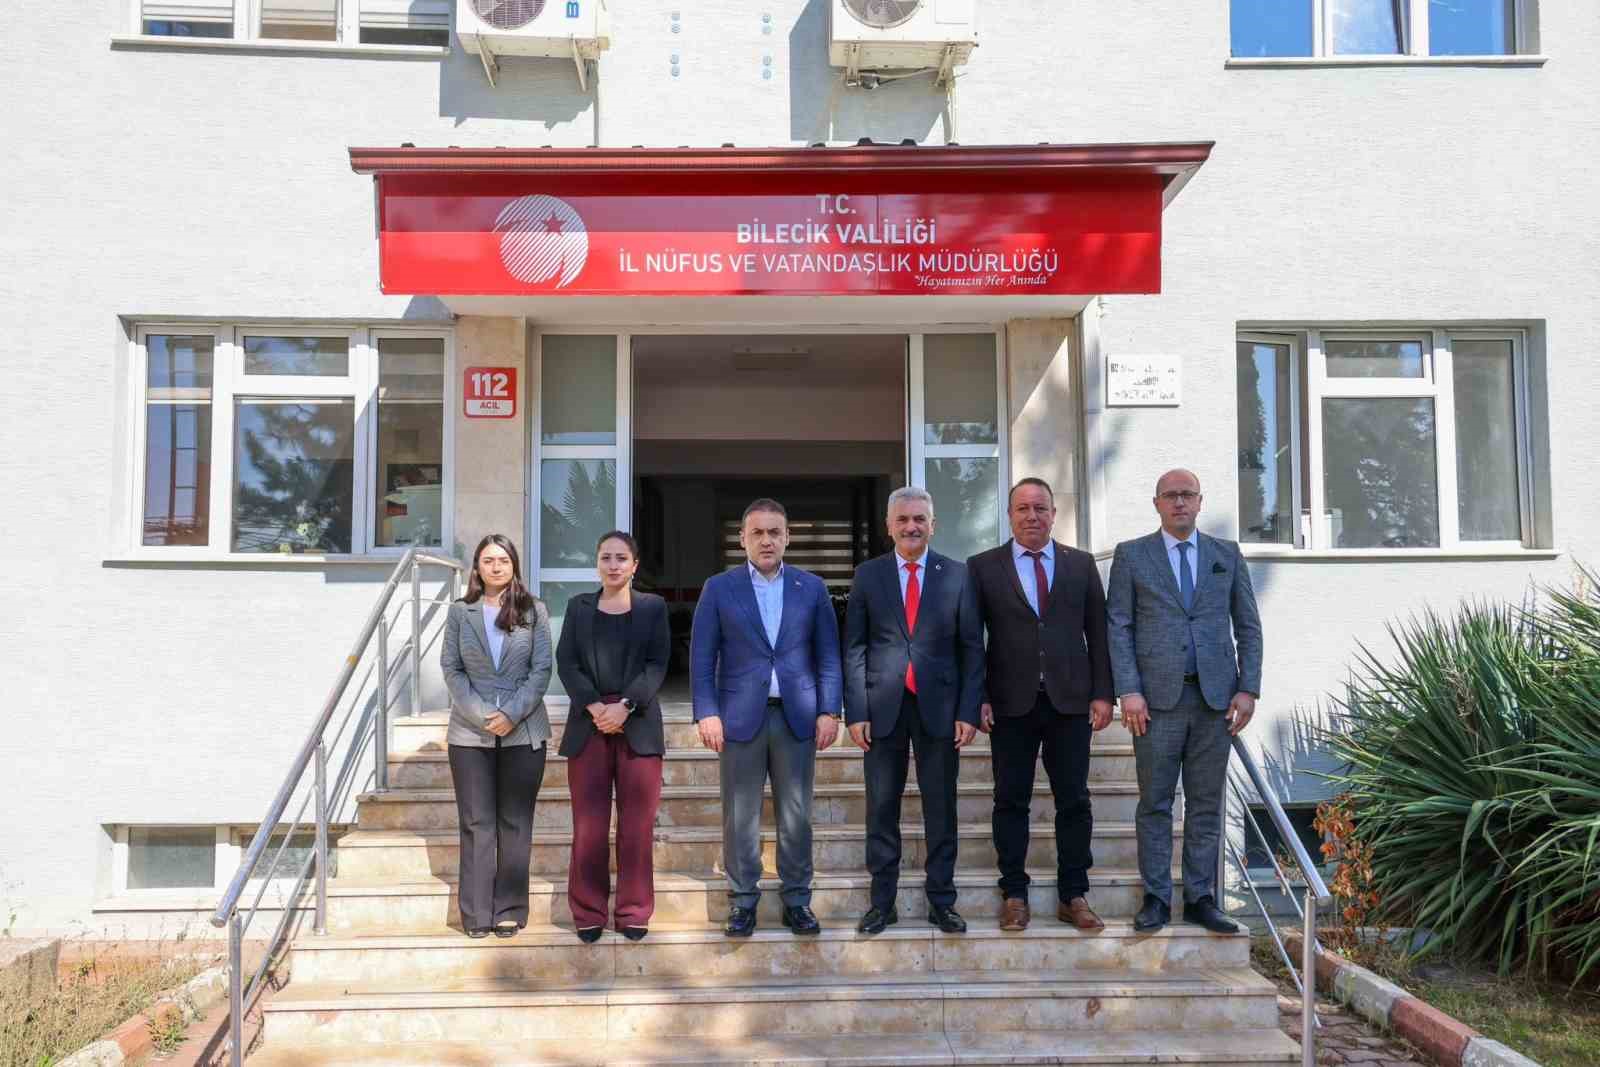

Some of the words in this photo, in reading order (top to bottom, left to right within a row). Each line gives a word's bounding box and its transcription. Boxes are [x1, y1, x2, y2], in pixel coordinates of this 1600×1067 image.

[816, 193, 857, 215] T.C.
[736, 218, 830, 244] BİLECİK
[836, 217, 937, 244] VALİLİĞİ
[618, 248, 640, 273] İL
[646, 248, 724, 273] NÜFUS
[728, 253, 757, 273] VE
[763, 252, 912, 276] VATANDAŞLIK
[918, 247, 1059, 273] MÜDÜRLÜĞÜ
[985, 274, 1005, 287] Her
[471, 372, 508, 397] 112
